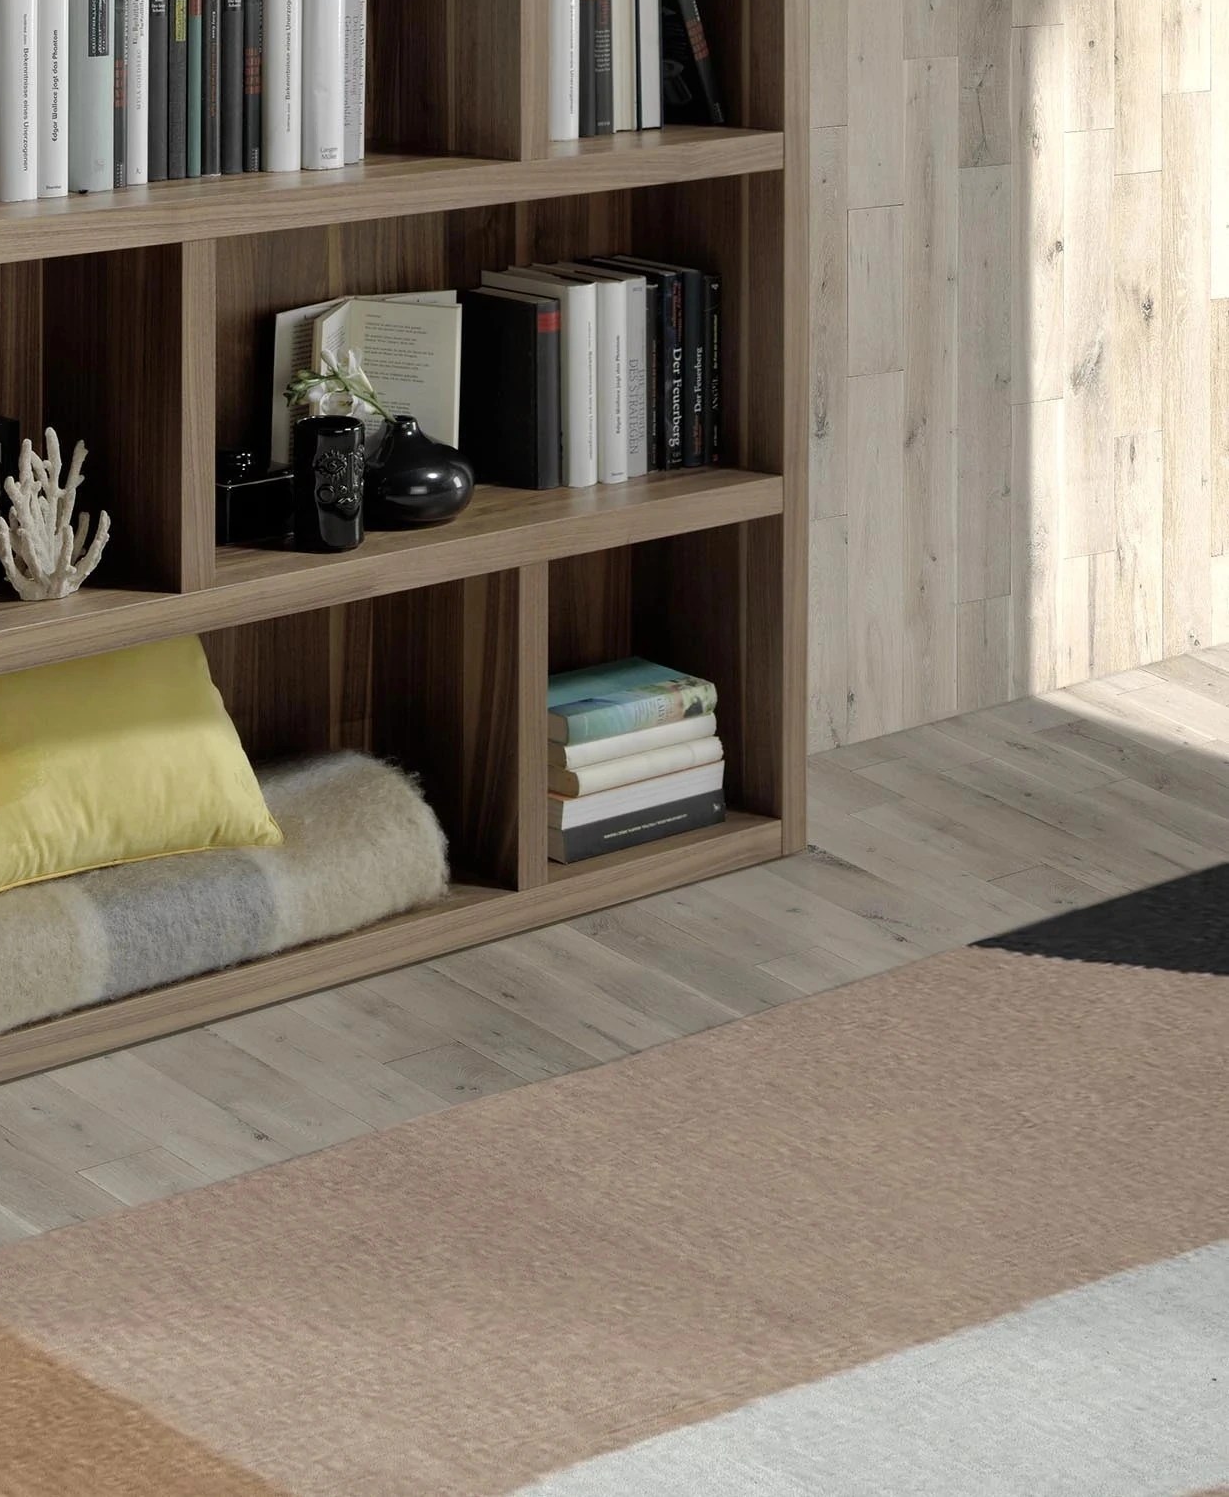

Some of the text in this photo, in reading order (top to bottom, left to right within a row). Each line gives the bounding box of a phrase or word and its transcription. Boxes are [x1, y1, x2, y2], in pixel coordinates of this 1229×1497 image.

[673, 347, 682, 374] Der
[694, 347, 703, 412] Der Feuerberg
[629, 359, 639, 454] DES STRATEGEN
[669, 378, 682, 447] Feuerberg
